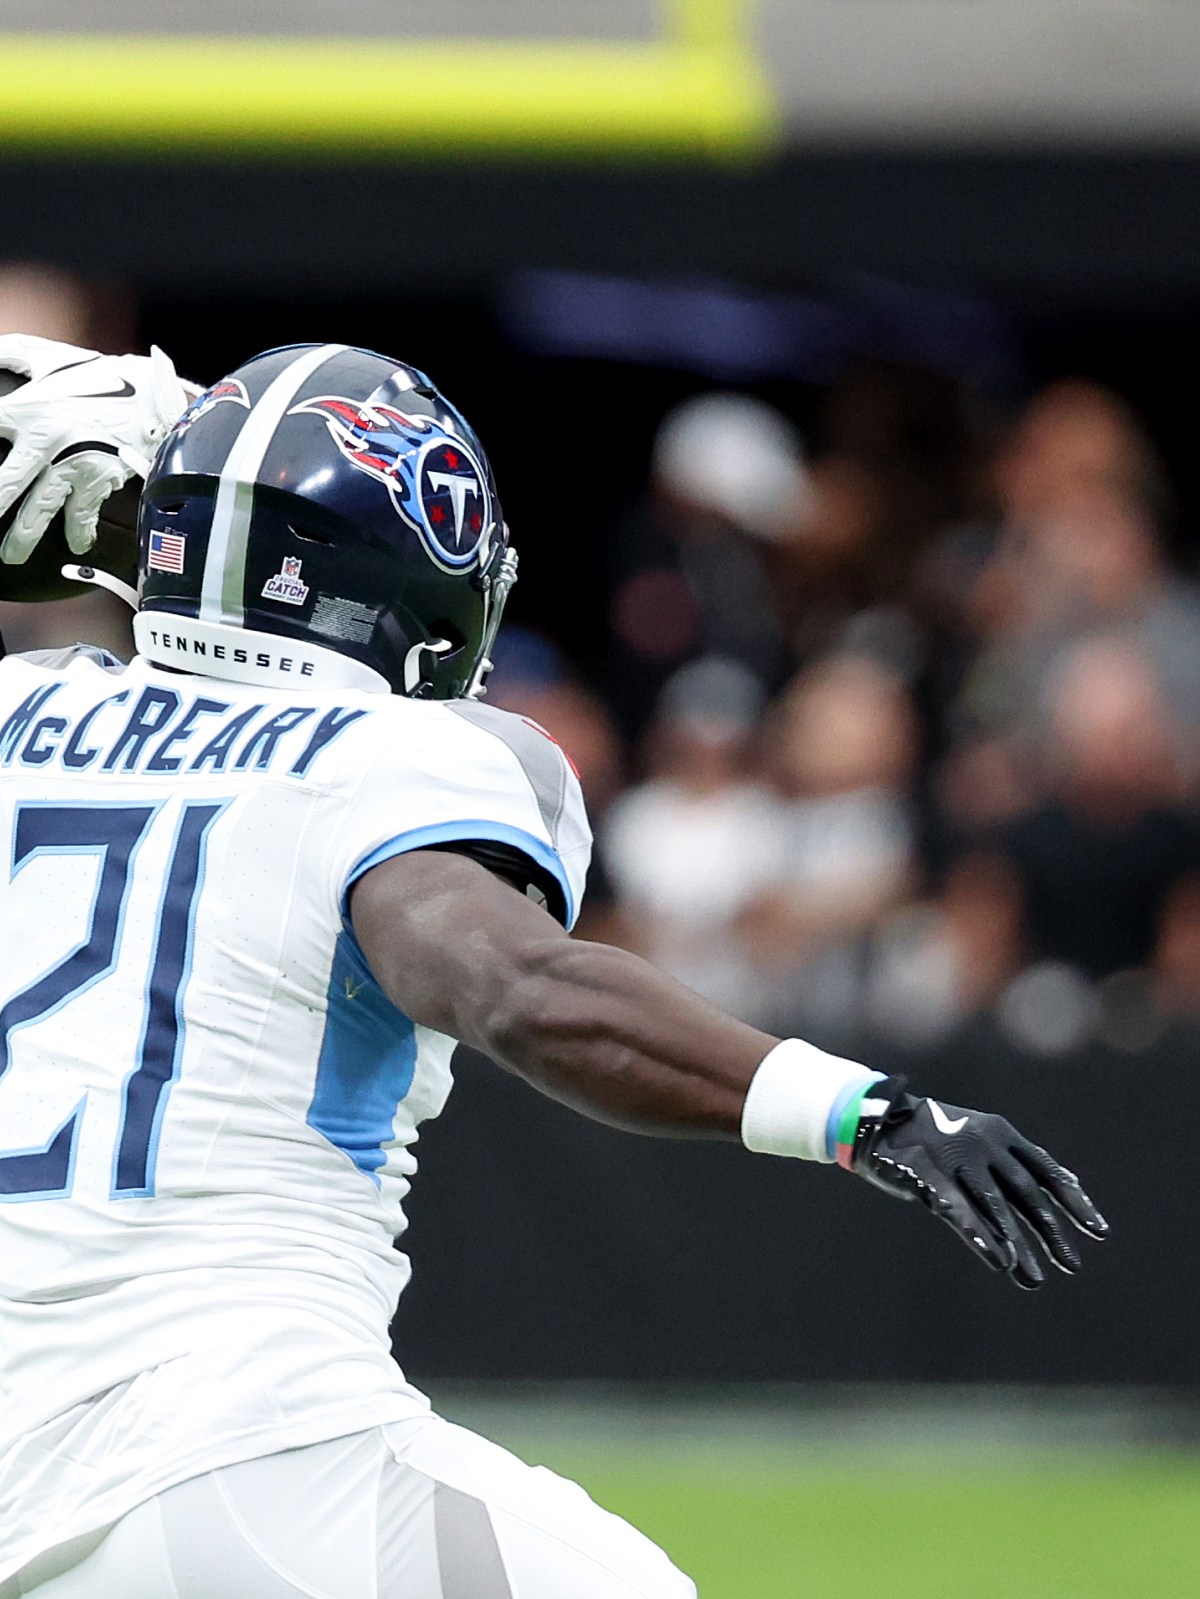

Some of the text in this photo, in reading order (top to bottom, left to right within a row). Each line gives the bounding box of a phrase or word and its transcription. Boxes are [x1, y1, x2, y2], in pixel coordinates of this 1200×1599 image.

[426, 470, 478, 547] T
[266, 580, 306, 598] CATCH
[150, 631, 315, 676] TENNESSEE
